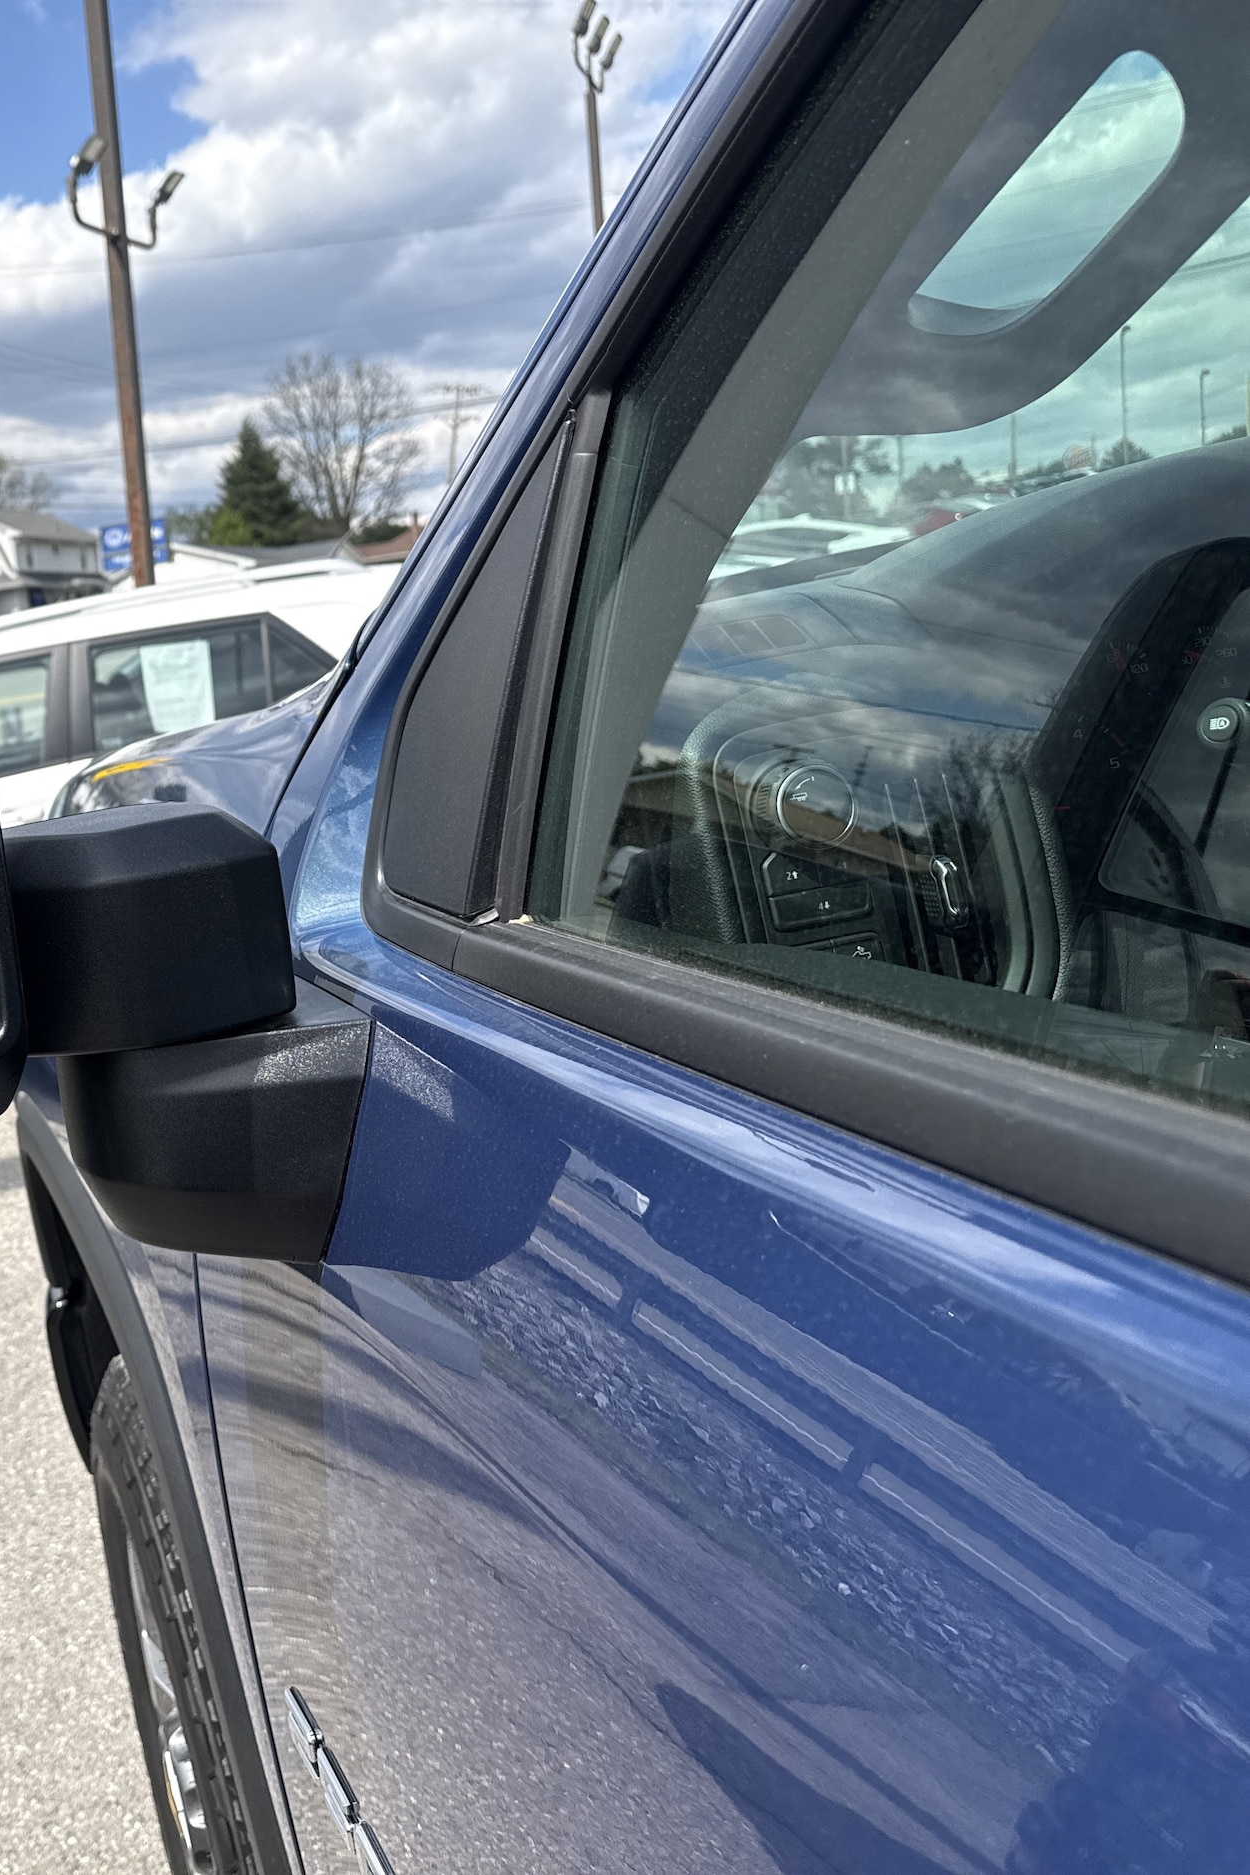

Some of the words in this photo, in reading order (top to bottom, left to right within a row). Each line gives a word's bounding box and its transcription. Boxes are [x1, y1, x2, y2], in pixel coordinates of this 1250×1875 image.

[1072, 728, 1083, 740] 4
[1109, 756, 1121, 769] 5
[785, 871, 792, 881] 2
[818, 901, 824, 910] 4
